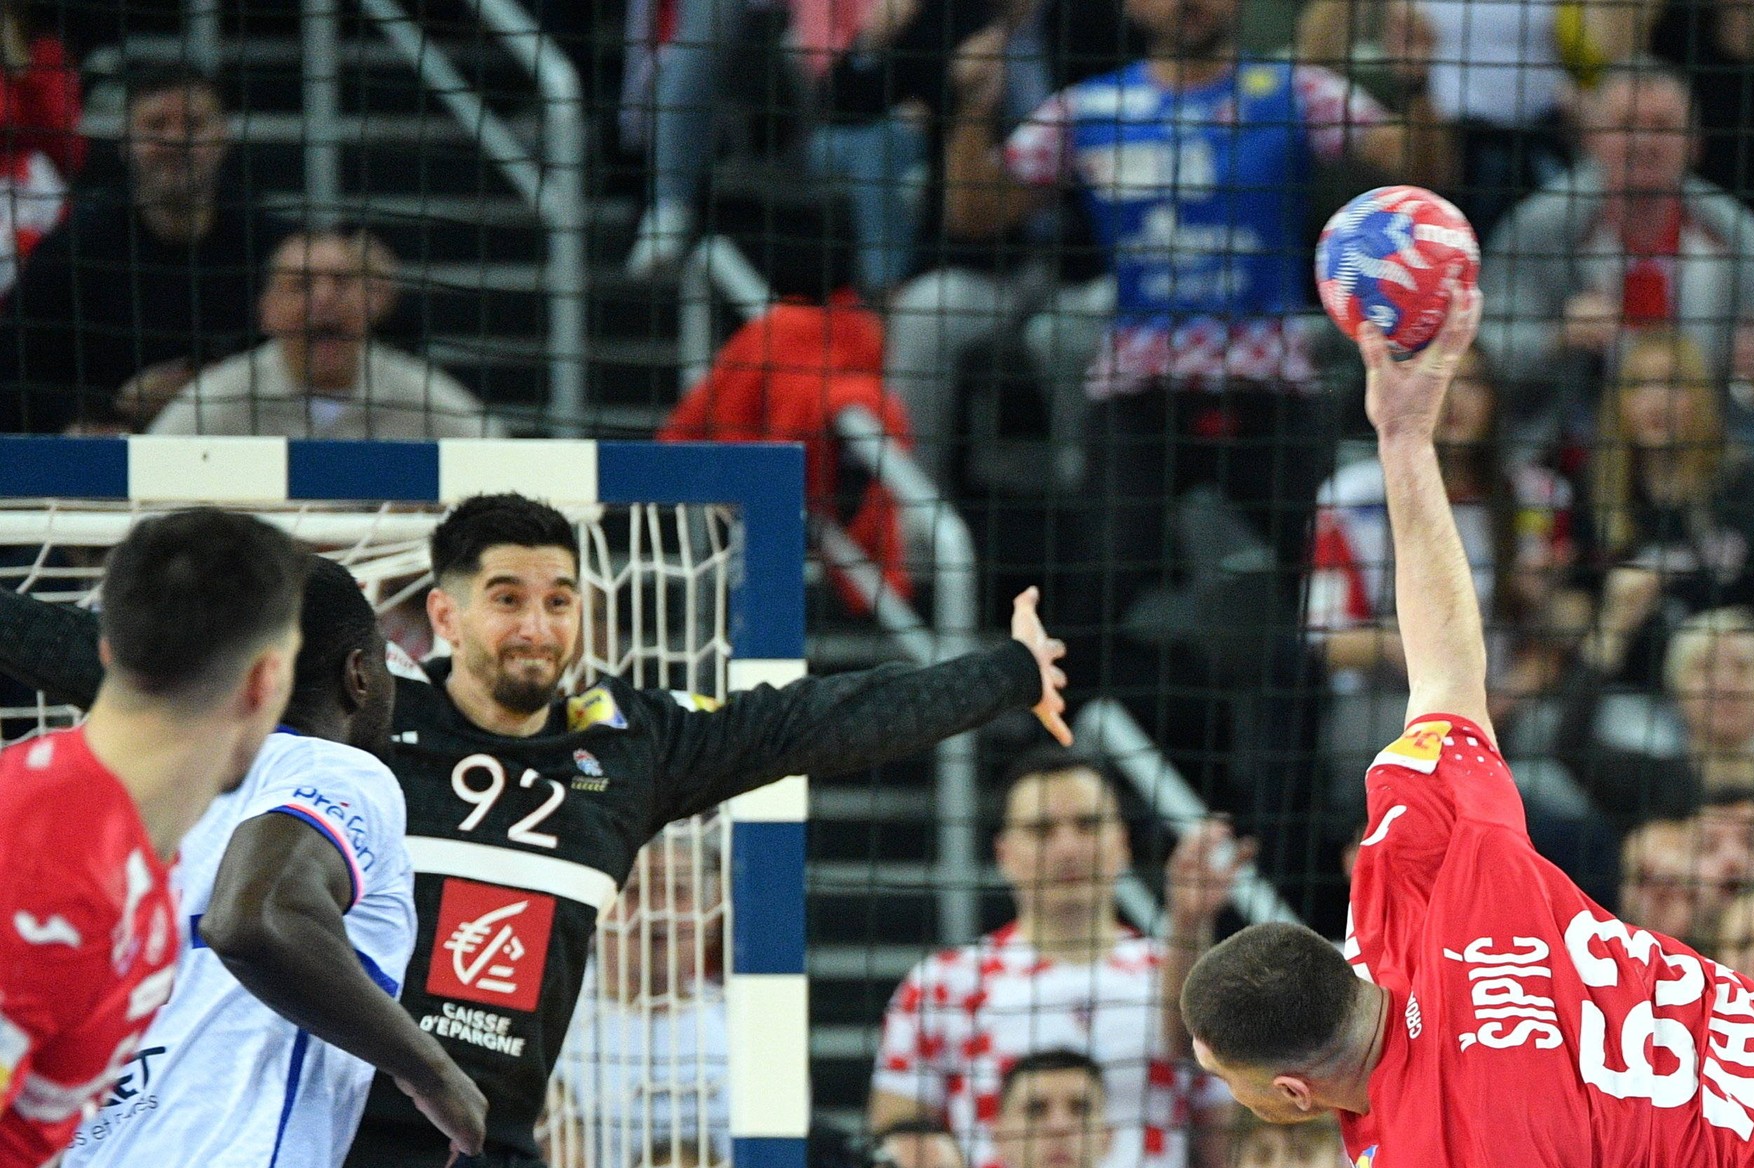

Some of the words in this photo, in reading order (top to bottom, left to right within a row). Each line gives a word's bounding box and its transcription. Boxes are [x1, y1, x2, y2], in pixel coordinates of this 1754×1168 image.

[451, 752, 566, 849] 92
[442, 1002, 512, 1034] CAISSE
[1443, 934, 1564, 1052] ŠIPIĆ
[1564, 908, 1705, 1109] 63
